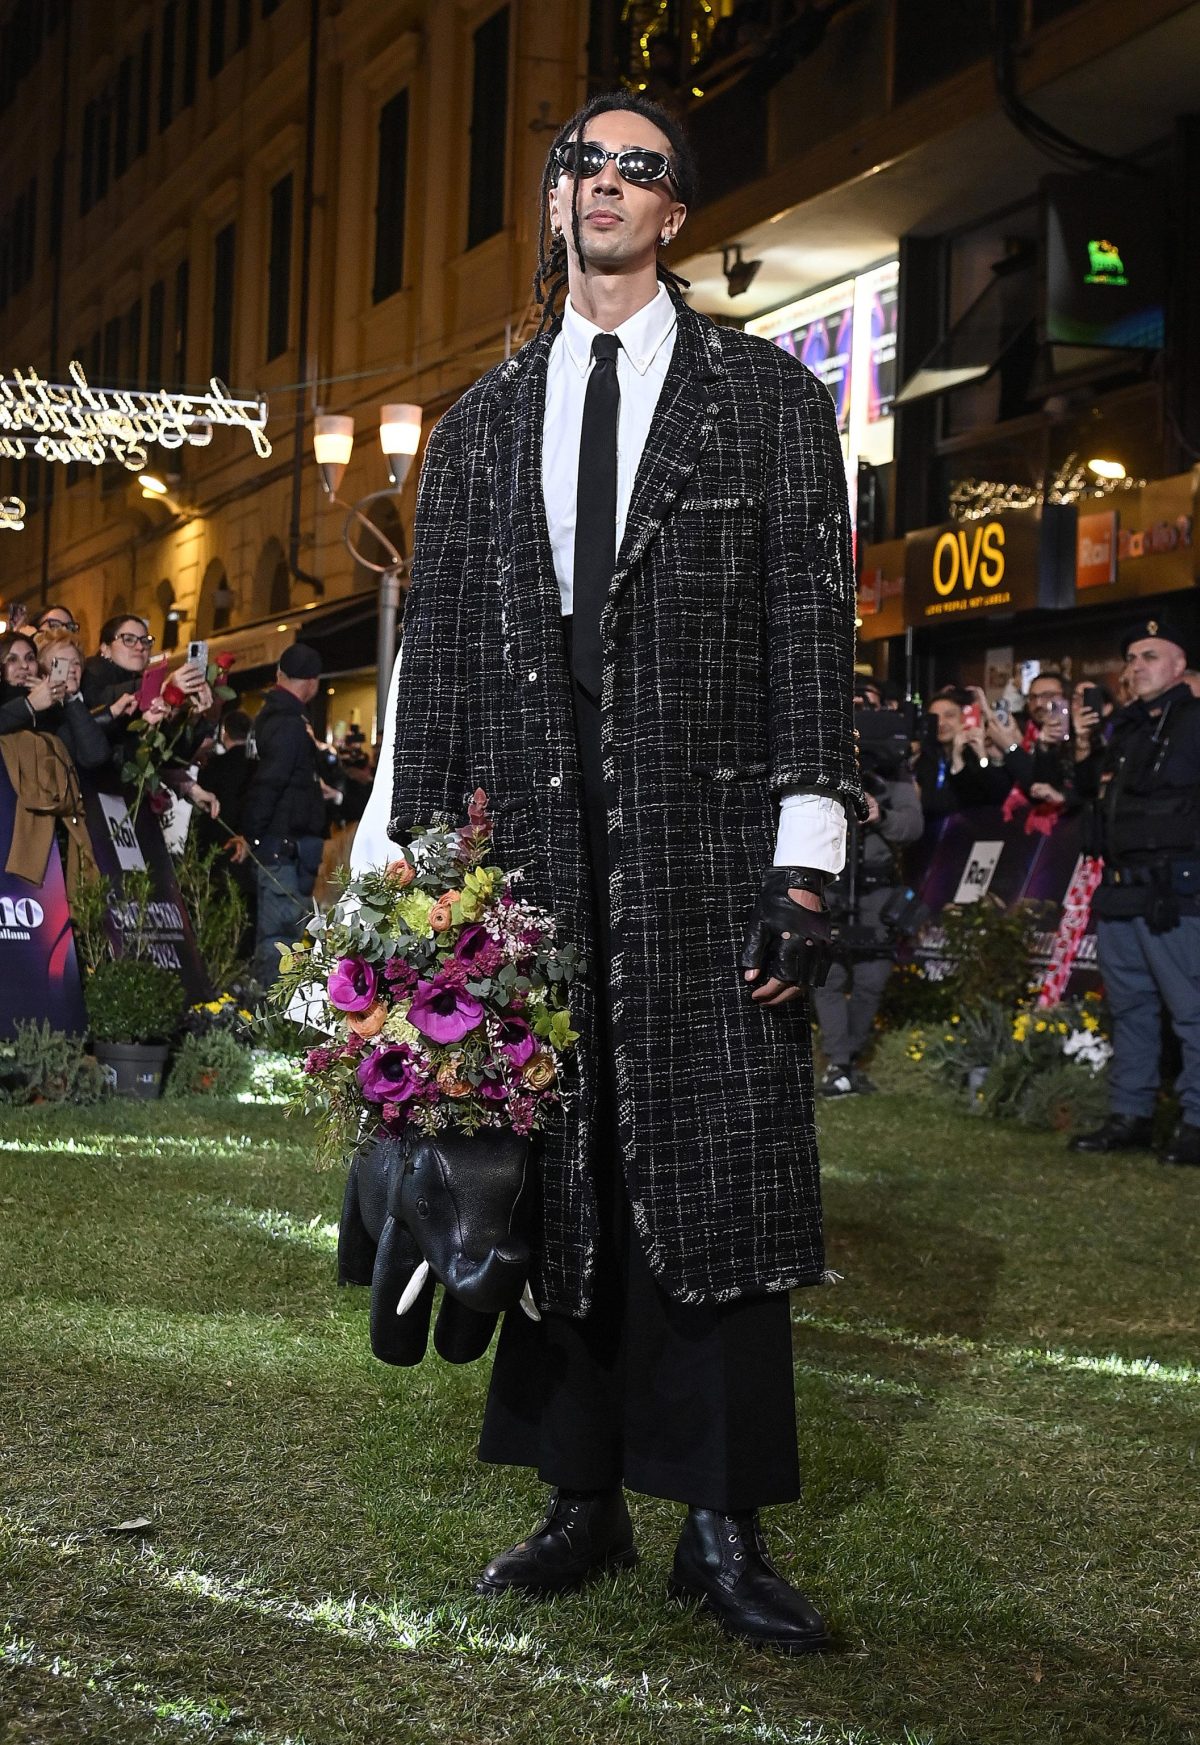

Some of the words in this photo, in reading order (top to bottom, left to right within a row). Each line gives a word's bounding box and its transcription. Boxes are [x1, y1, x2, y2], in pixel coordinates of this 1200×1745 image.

[932, 522, 1005, 596] OVS
[108, 815, 138, 849] Rai
[964, 858, 995, 886] Rai
